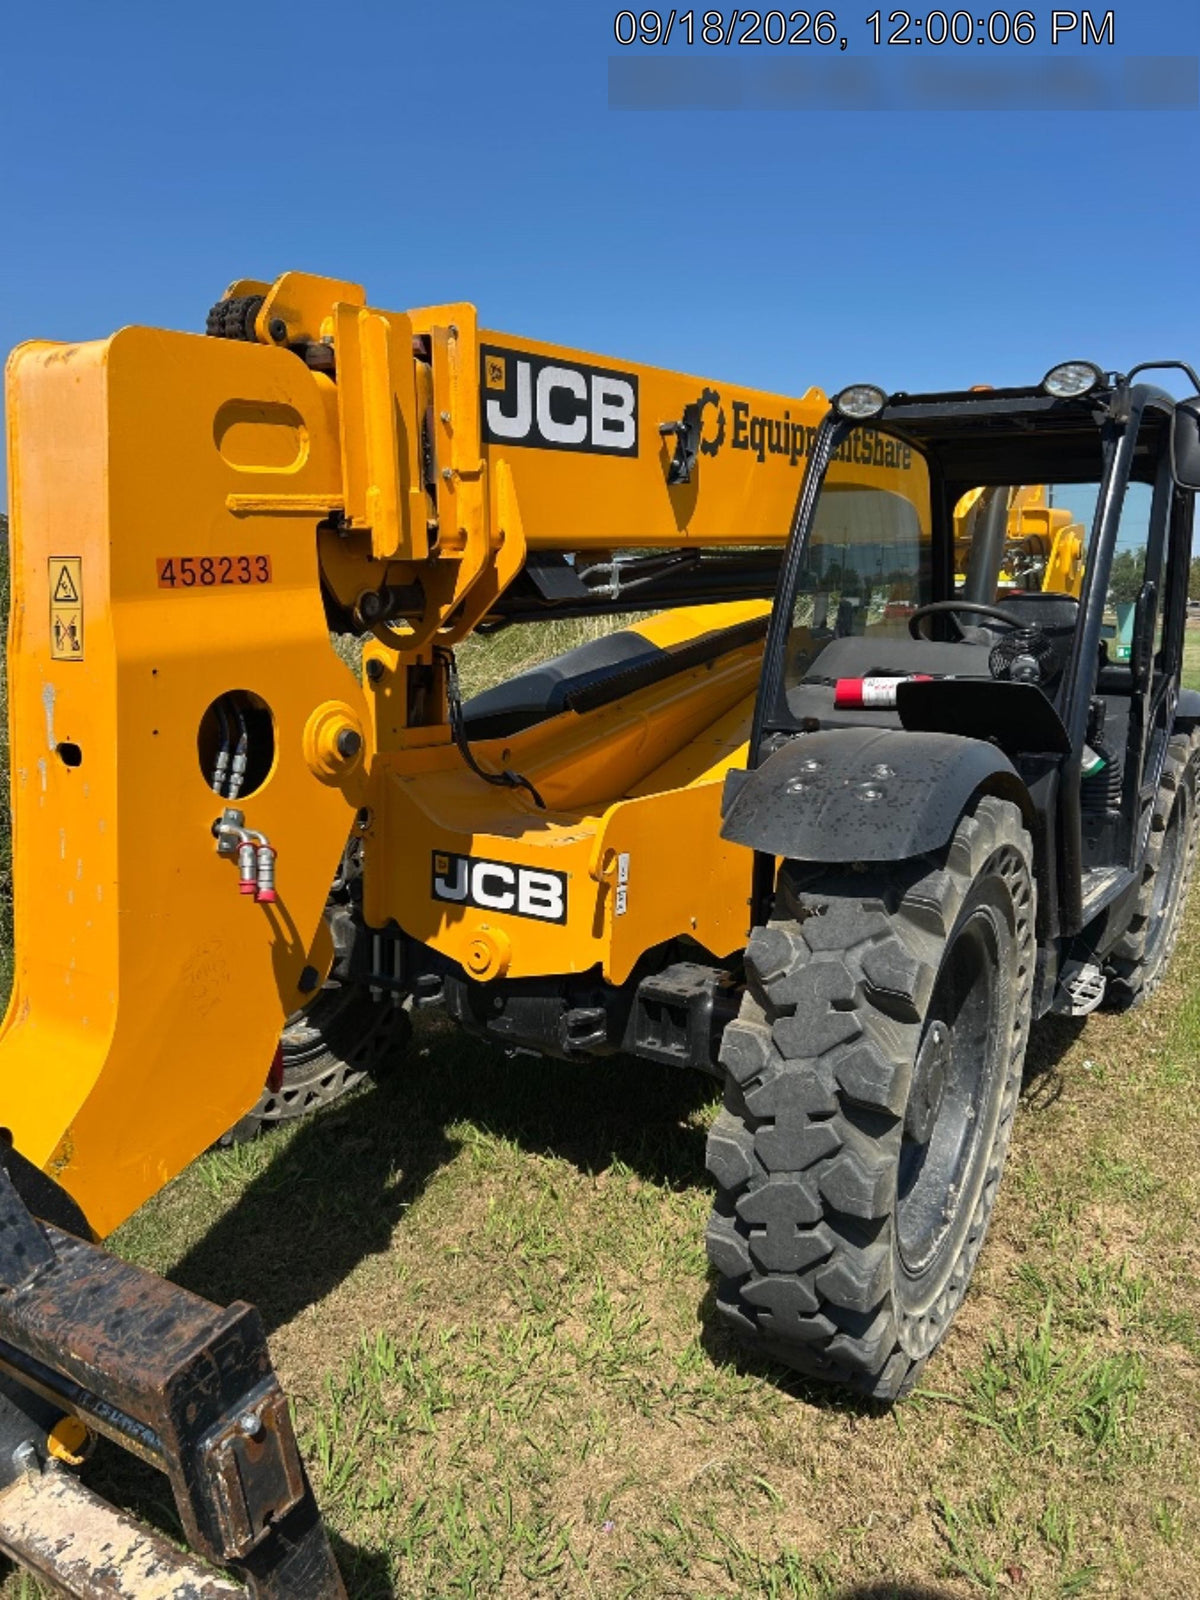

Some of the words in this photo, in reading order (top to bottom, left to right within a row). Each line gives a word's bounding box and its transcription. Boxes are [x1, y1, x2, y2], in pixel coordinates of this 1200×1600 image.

[486, 360, 636, 449] JCB
[731, 400, 912, 469] EquipntShare
[160, 556, 270, 587] 458233
[434, 858, 565, 919] JCB
